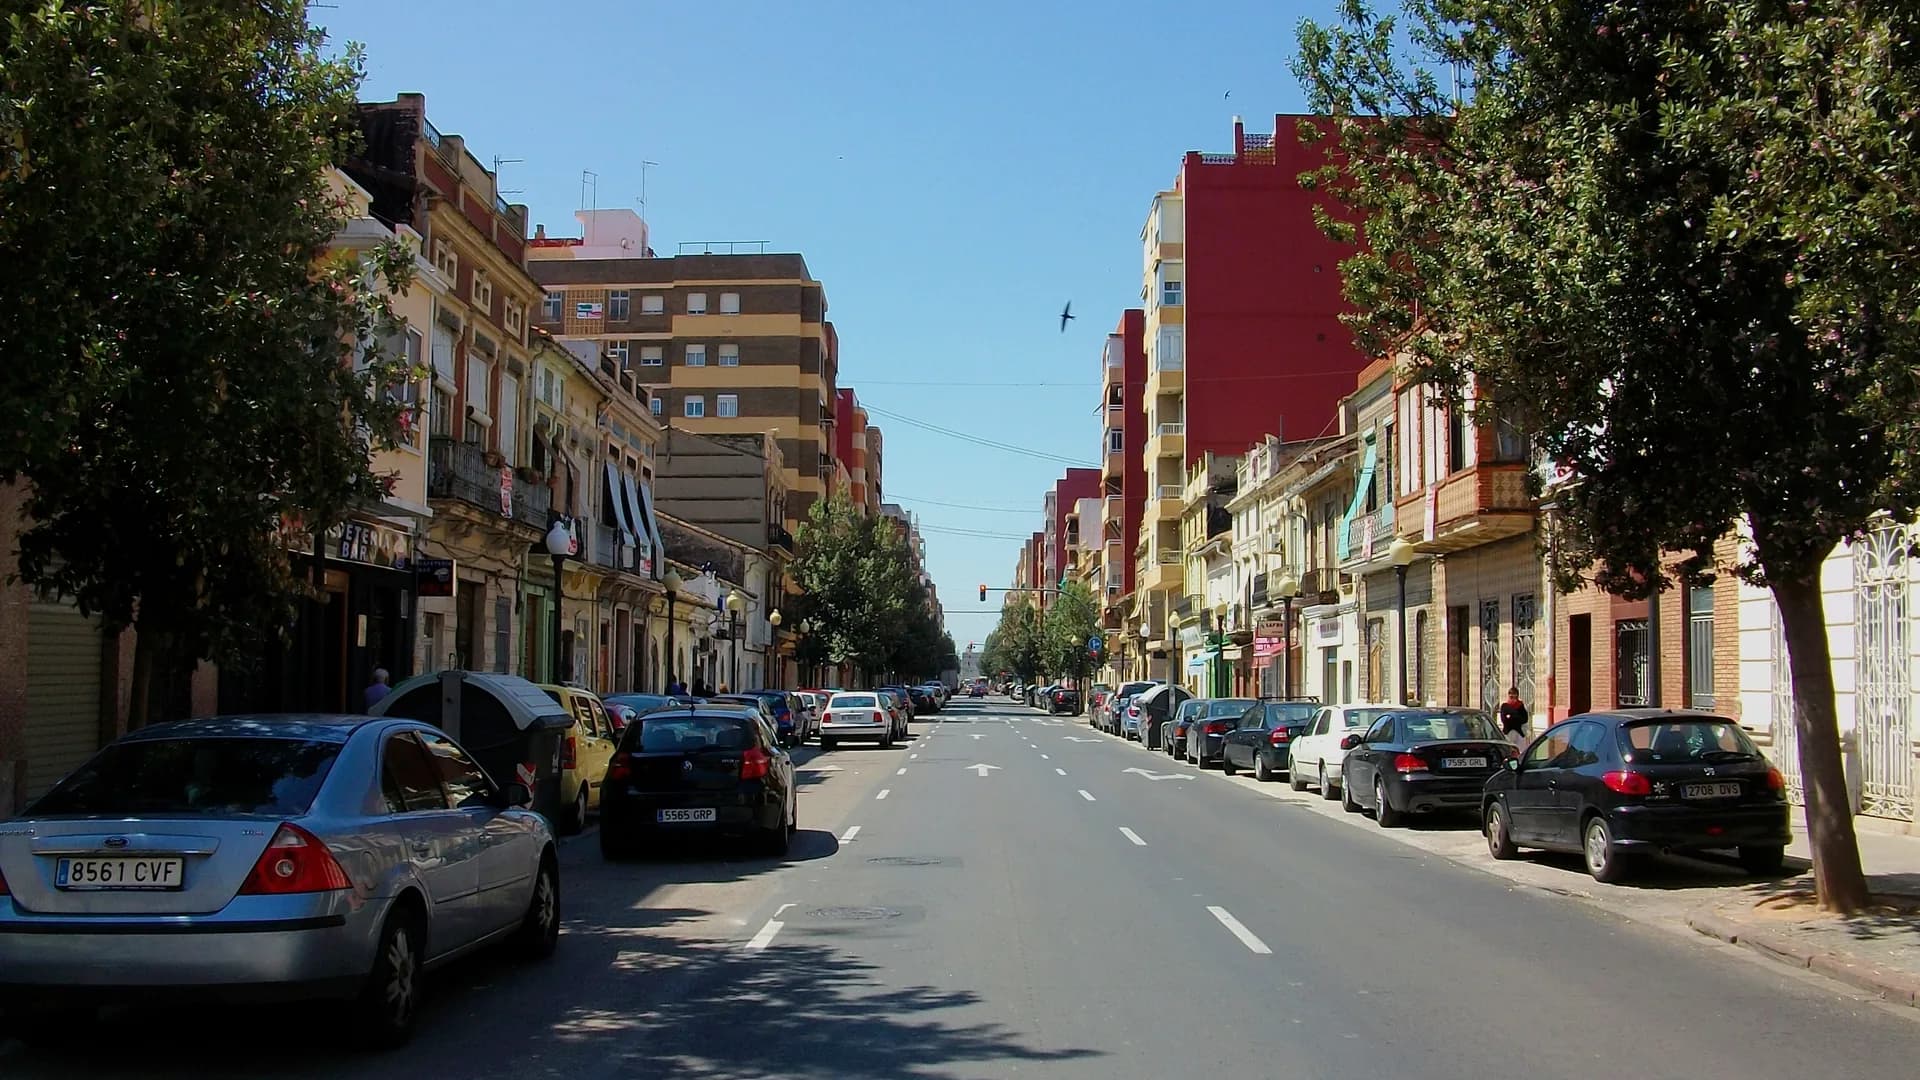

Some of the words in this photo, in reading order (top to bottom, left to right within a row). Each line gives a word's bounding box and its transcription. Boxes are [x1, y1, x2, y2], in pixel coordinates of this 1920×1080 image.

[341, 540, 369, 561] BAR
[1687, 784, 1714, 797] 2708
[664, 810, 690, 820] 5565
[693, 809, 712, 820] GRP
[71, 861, 125, 882] 8561
[134, 861, 177, 882] CVF
